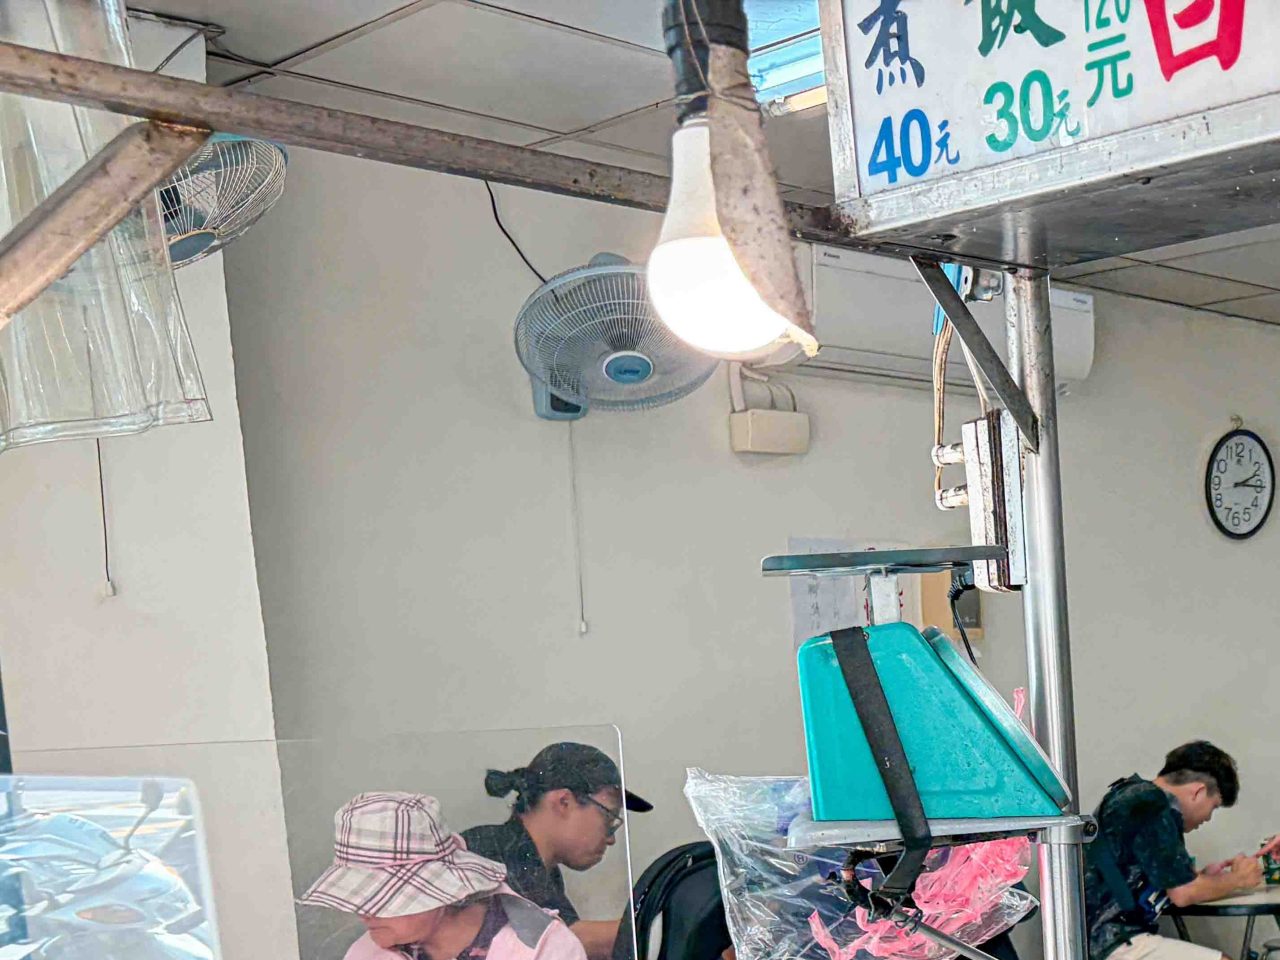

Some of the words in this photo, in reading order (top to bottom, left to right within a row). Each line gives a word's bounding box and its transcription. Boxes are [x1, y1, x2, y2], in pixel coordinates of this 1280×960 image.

[983, 69, 1081, 152] 30元
[868, 108, 960, 184] 40元
[1226, 445, 1233, 460] 11
[1235, 442, 1245, 458] 12
[1248, 449, 1253, 462] 1
[1213, 476, 1221, 491] 9
[1215, 494, 1222, 508] 8
[1251, 496, 1258, 508] 4
[1224, 507, 1232, 521] 7
[1232, 511, 1240, 526] 6
[1243, 508, 1251, 522] 5
